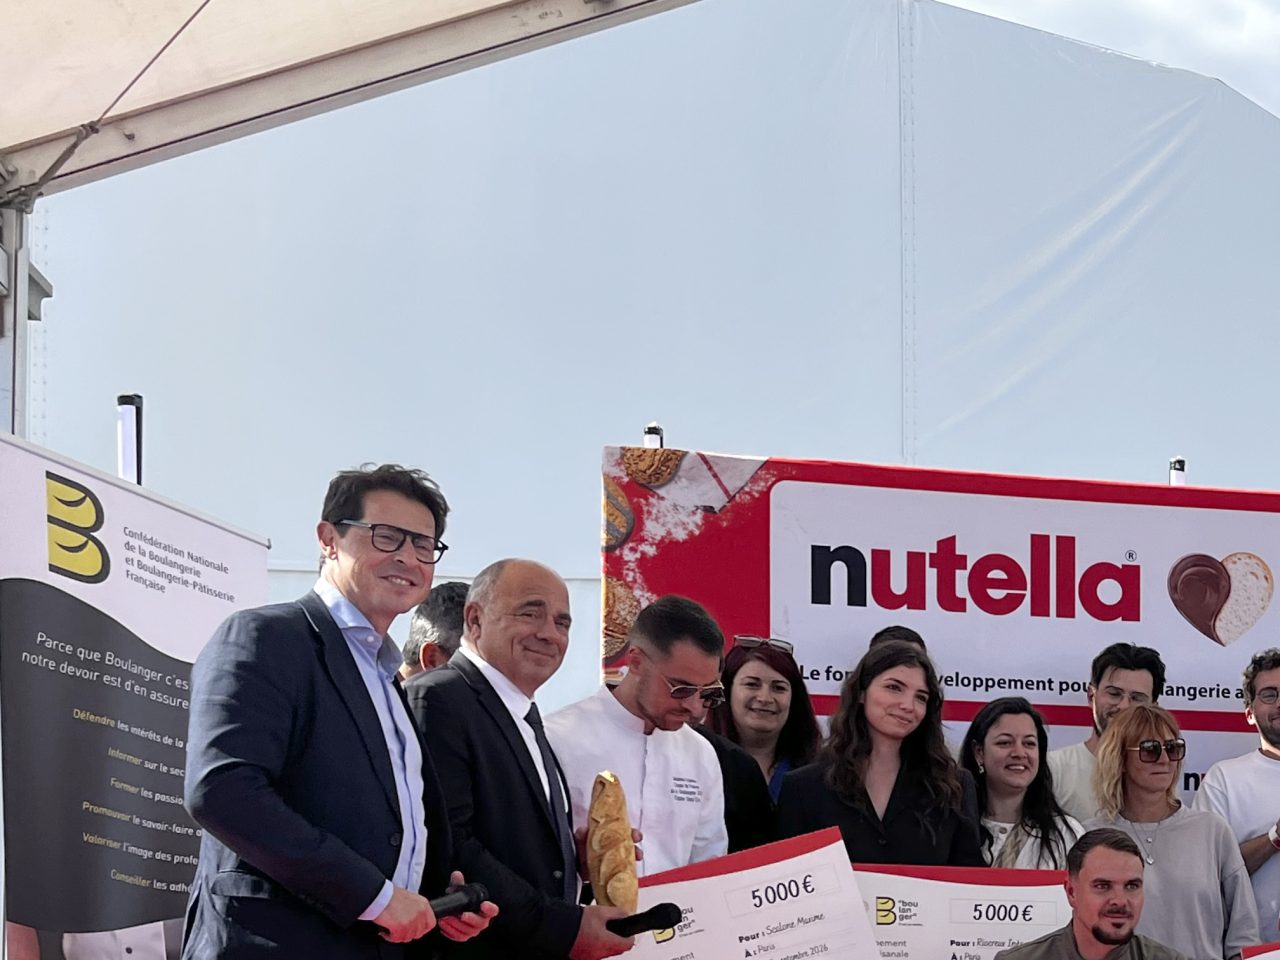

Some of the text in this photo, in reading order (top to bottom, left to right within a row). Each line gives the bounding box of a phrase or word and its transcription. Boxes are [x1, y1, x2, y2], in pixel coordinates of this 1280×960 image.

[123, 526, 229, 574] Confédération Nationale
[124, 541, 201, 578] de la Boulangerie
[125, 557, 134, 567] et
[126, 570, 165, 593] Française
[37, 632, 189, 690] Parce que Boulanger c'es
[22, 652, 189, 709] notre devoir est d'en assure
[800, 665, 820, 680] Le
[73, 708, 184, 748] Défendre les intérêts de la
[144, 760, 158, 770] sur
[160, 763, 168, 773] le
[140, 787, 153, 799] les
[133, 815, 140, 825] le
[142, 819, 193, 835] savoir-faire
[155, 851, 171, 861] des
[154, 880, 167, 890] les
[738, 933, 760, 943] Pour
